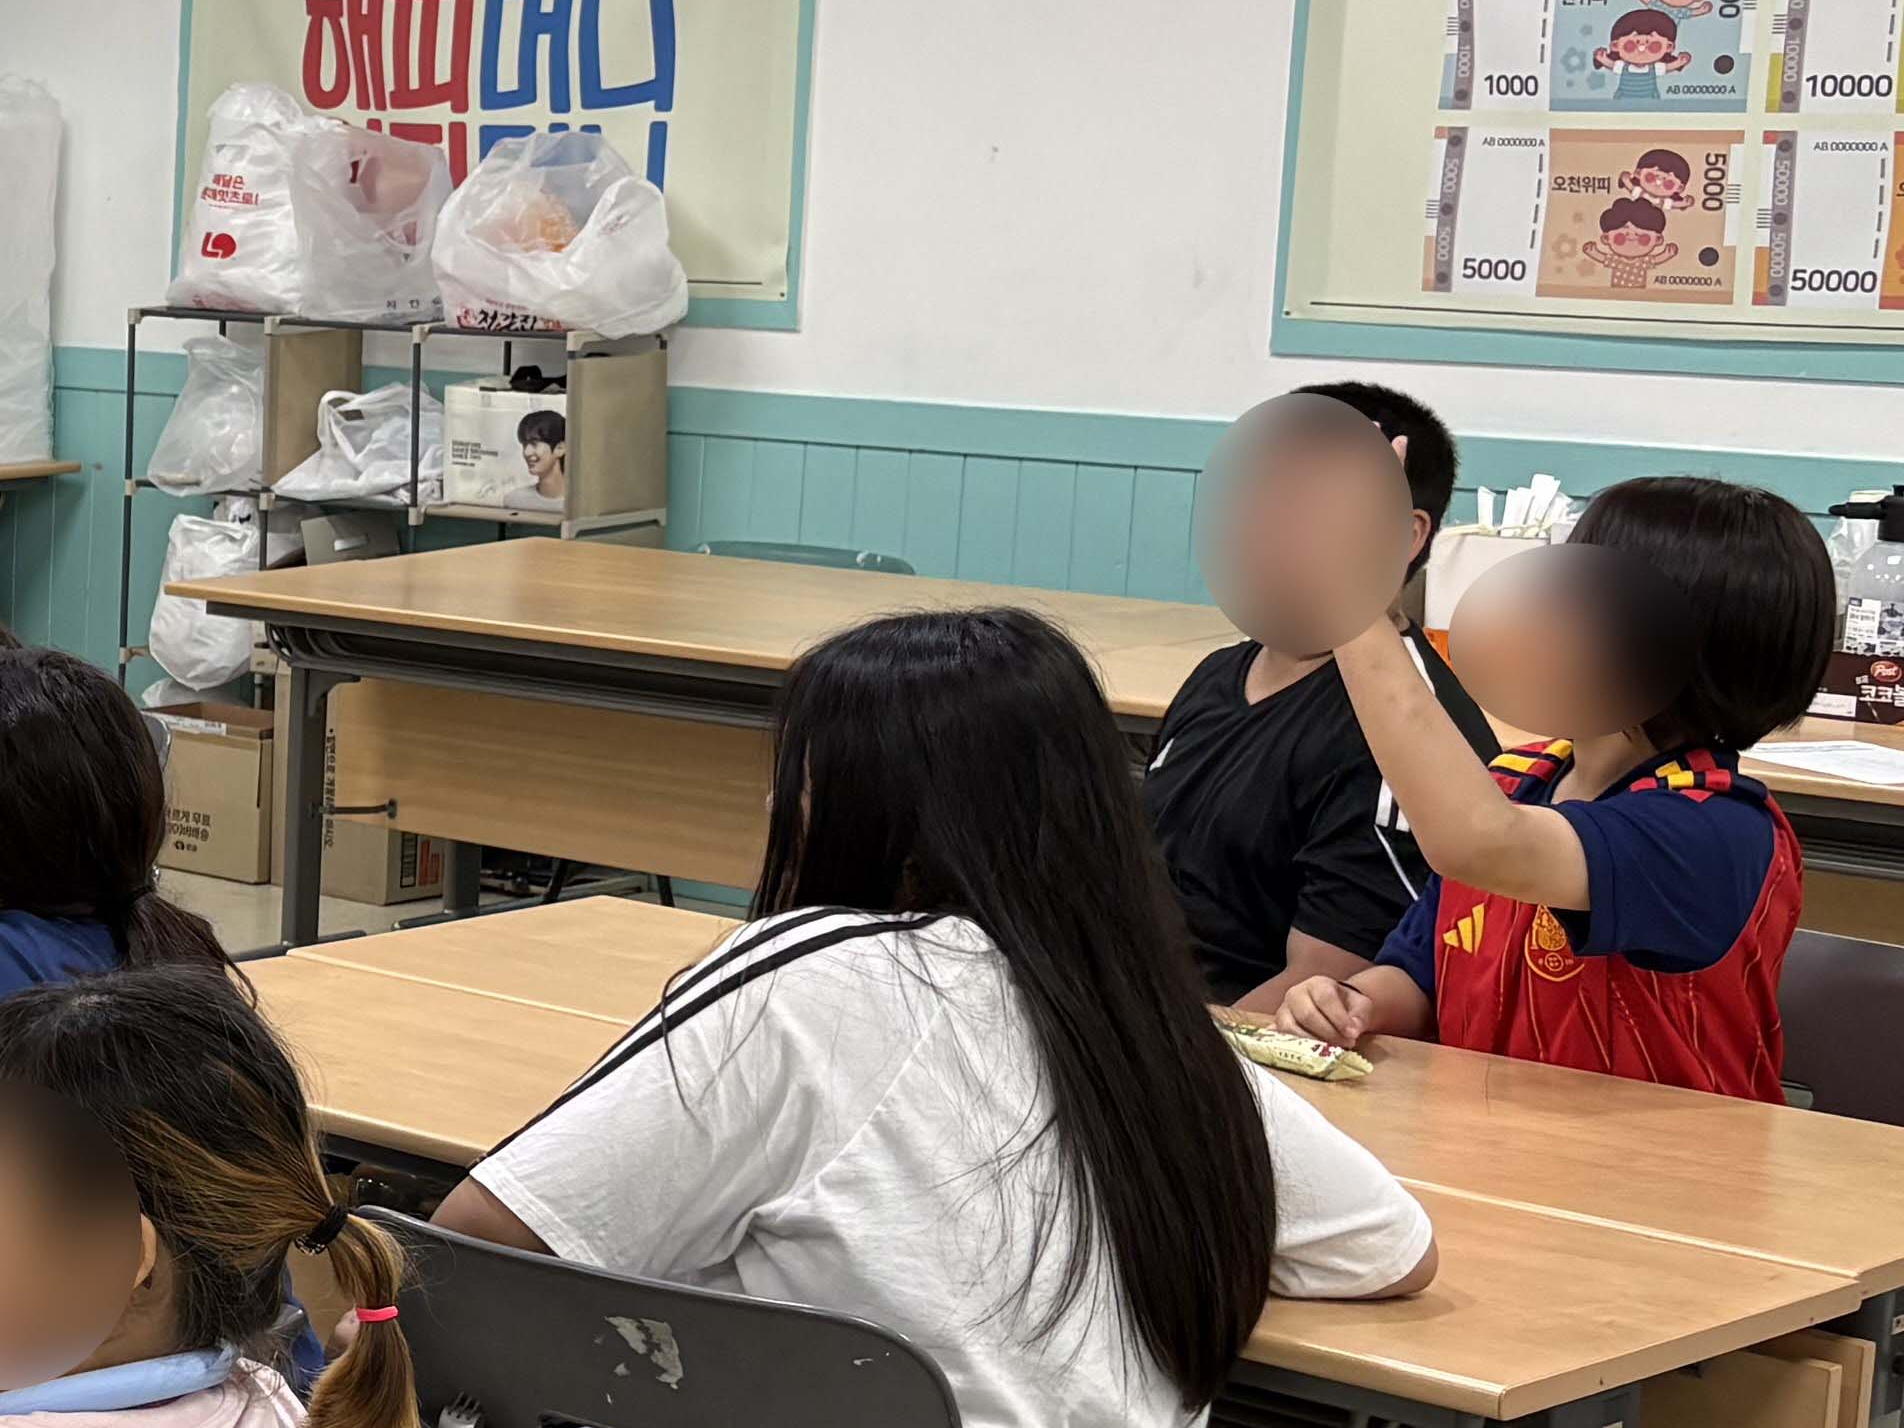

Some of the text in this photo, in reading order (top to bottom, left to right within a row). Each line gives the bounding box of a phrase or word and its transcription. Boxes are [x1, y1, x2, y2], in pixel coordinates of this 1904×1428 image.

[1484, 75, 1539, 97] 1000
[1806, 75, 1893, 97] 10000
[1445, 159, 1459, 193] 5000
[1552, 176, 1611, 194] 오천위피
[1702, 153, 1727, 212] 5000
[1462, 259, 1526, 281] 5000
[1791, 269, 1877, 294] 50000
[1874, 664, 1898, 677] Post
